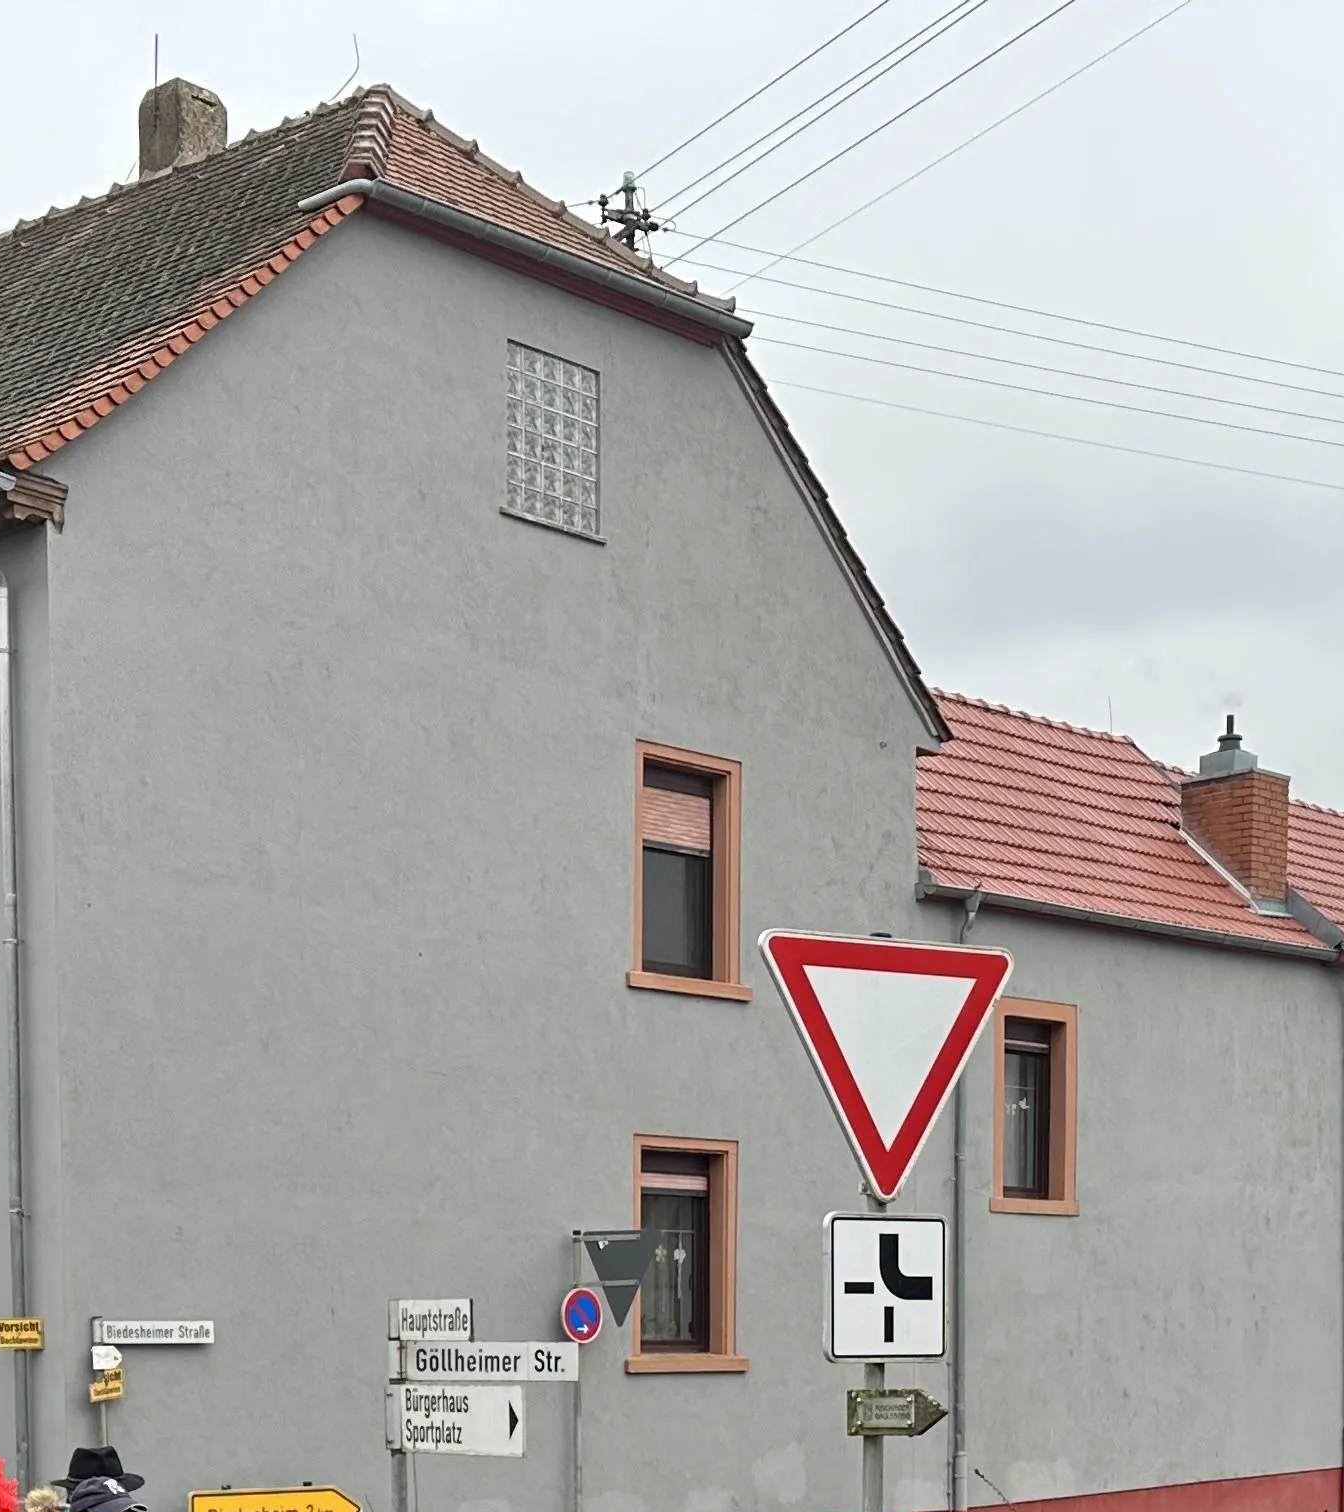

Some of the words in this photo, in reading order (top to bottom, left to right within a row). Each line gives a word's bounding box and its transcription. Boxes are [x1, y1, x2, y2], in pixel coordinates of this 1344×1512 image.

[106, 1323, 174, 1339] Biedesheimer
[178, 1324, 211, 1339] Straße
[401, 1306, 468, 1338] Hauptstraße
[416, 1348, 521, 1373] Göllheimer
[533, 1349, 565, 1373] Str.
[405, 1387, 469, 1419] Bürgerhaus
[405, 1418, 463, 1450] Sportplatz
